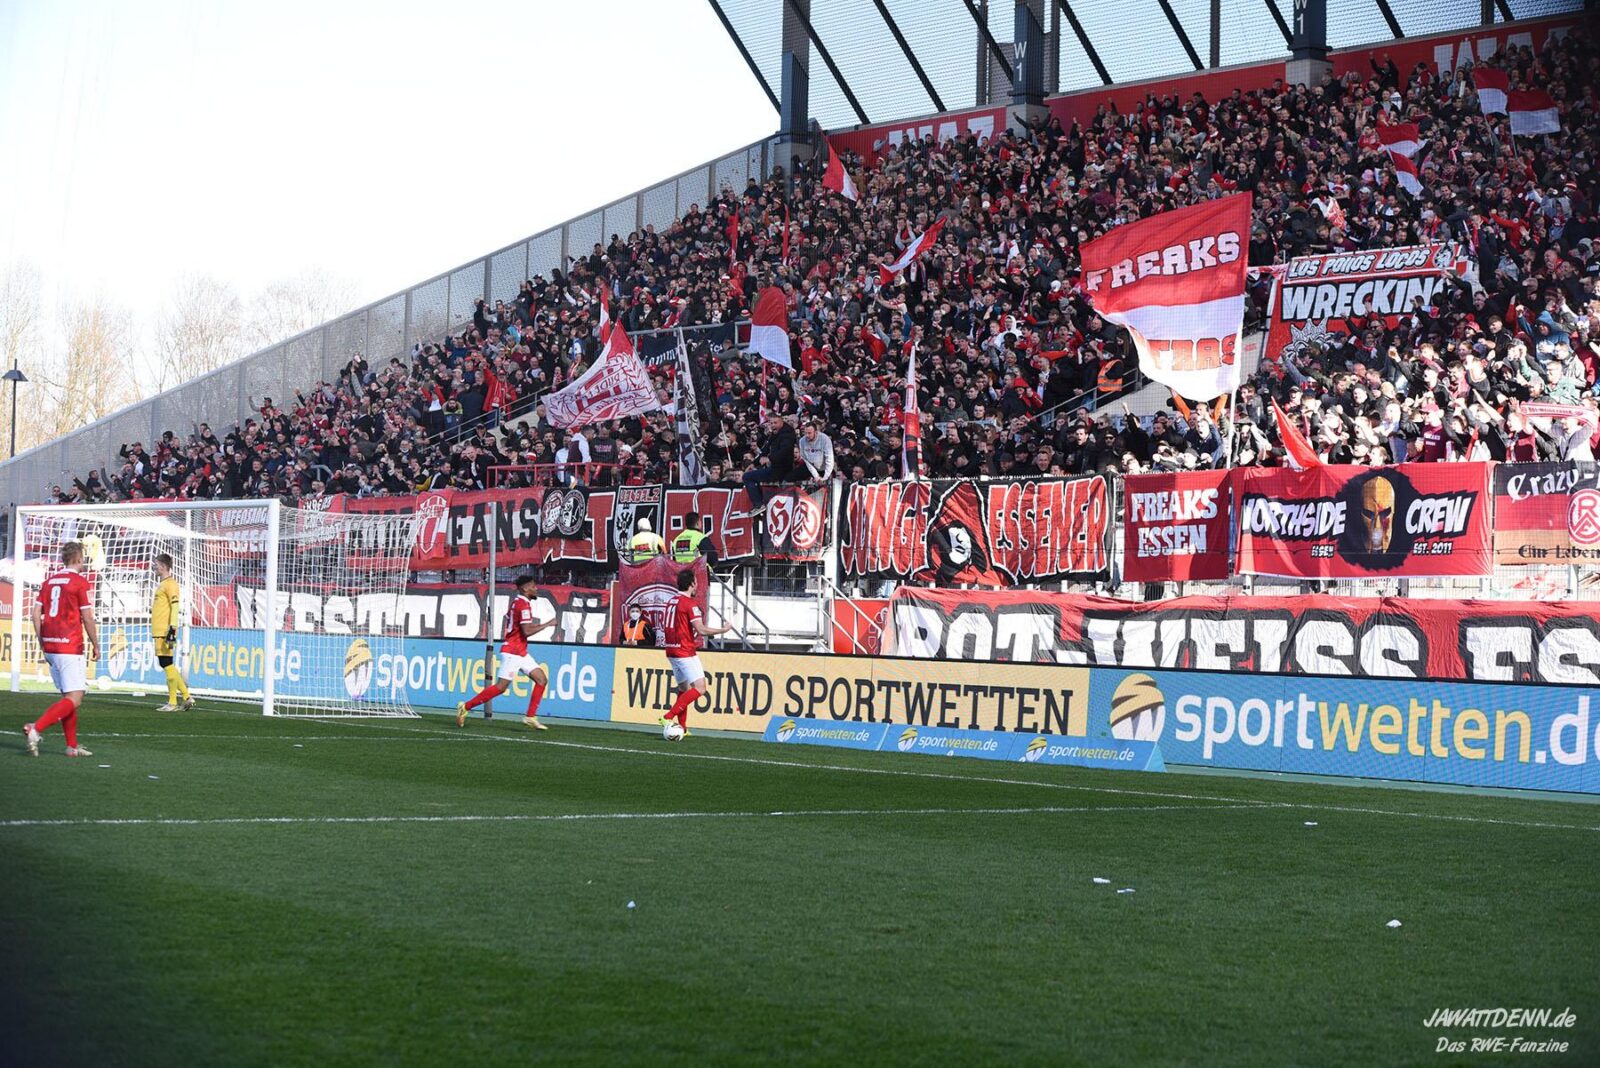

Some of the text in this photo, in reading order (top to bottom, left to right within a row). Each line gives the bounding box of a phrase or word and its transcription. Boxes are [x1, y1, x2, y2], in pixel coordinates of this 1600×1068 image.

[1297, 13, 1304, 35] 1
[1014, 41, 1027, 59] W
[1016, 62, 1022, 81] 1
[1085, 231, 1241, 292] FREAKS
[1289, 260, 1320, 278] LOS
[1376, 249, 1431, 269] LOCOS
[1131, 488, 1219, 522] FREAKS
[1242, 496, 1472, 537] NORTHSIDE CREW
[450, 498, 540, 556] FANS
[841, 475, 1110, 578] JUNGE ESSENER
[1138, 525, 1207, 557] ESSEN
[1413, 543, 1431, 554] EST.
[1431, 542, 1453, 555] 2011
[665, 605, 677, 629] 11
[784, 674, 1074, 736] SPORTWETTEN
[796, 726, 870, 742] sportwetten.de
[917, 735, 998, 752] sportwetten.de
[1174, 692, 1600, 767] sportwetten.d
[1047, 743, 1136, 762] sportwetten.de
